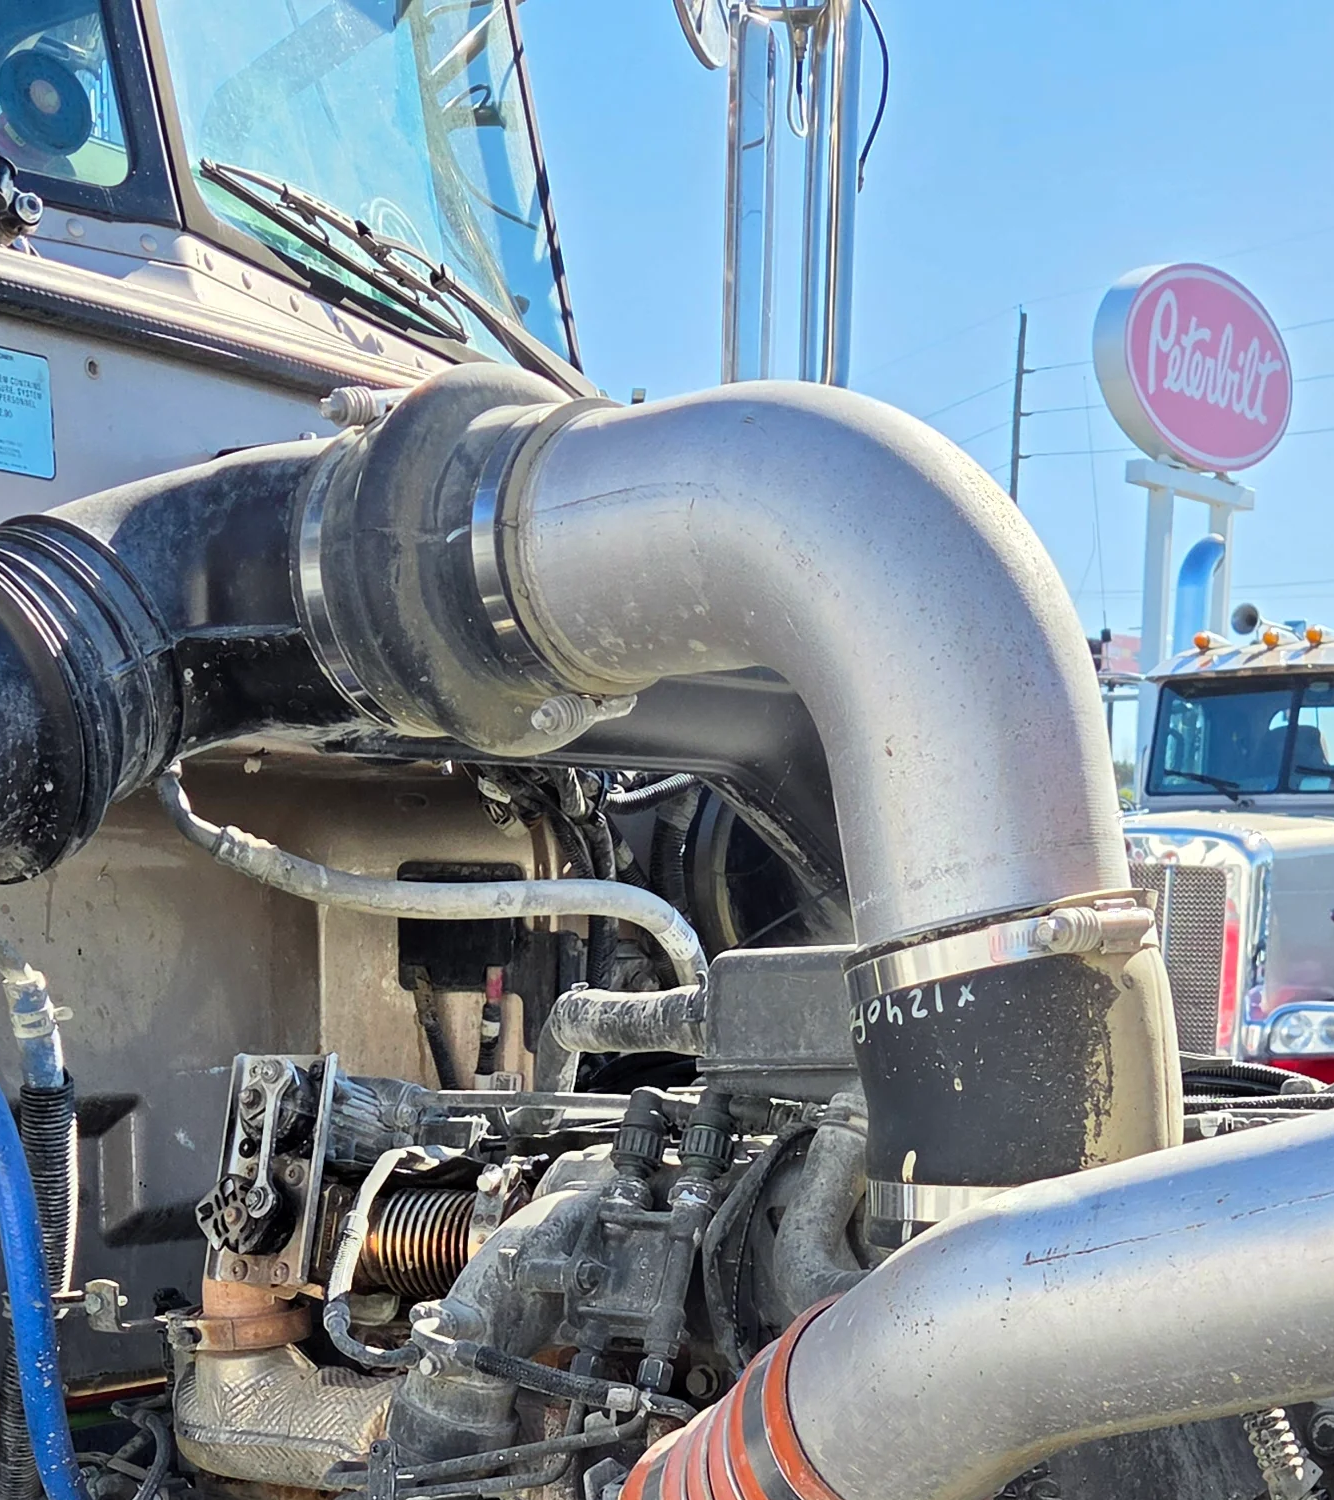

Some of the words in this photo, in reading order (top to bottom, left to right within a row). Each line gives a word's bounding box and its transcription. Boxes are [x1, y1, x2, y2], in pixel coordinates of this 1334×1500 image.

[1148, 287, 1282, 426] Peterbilt
[10, 374, 42, 391] CONTAINS
[16, 386, 43, 400] SYSTEM
